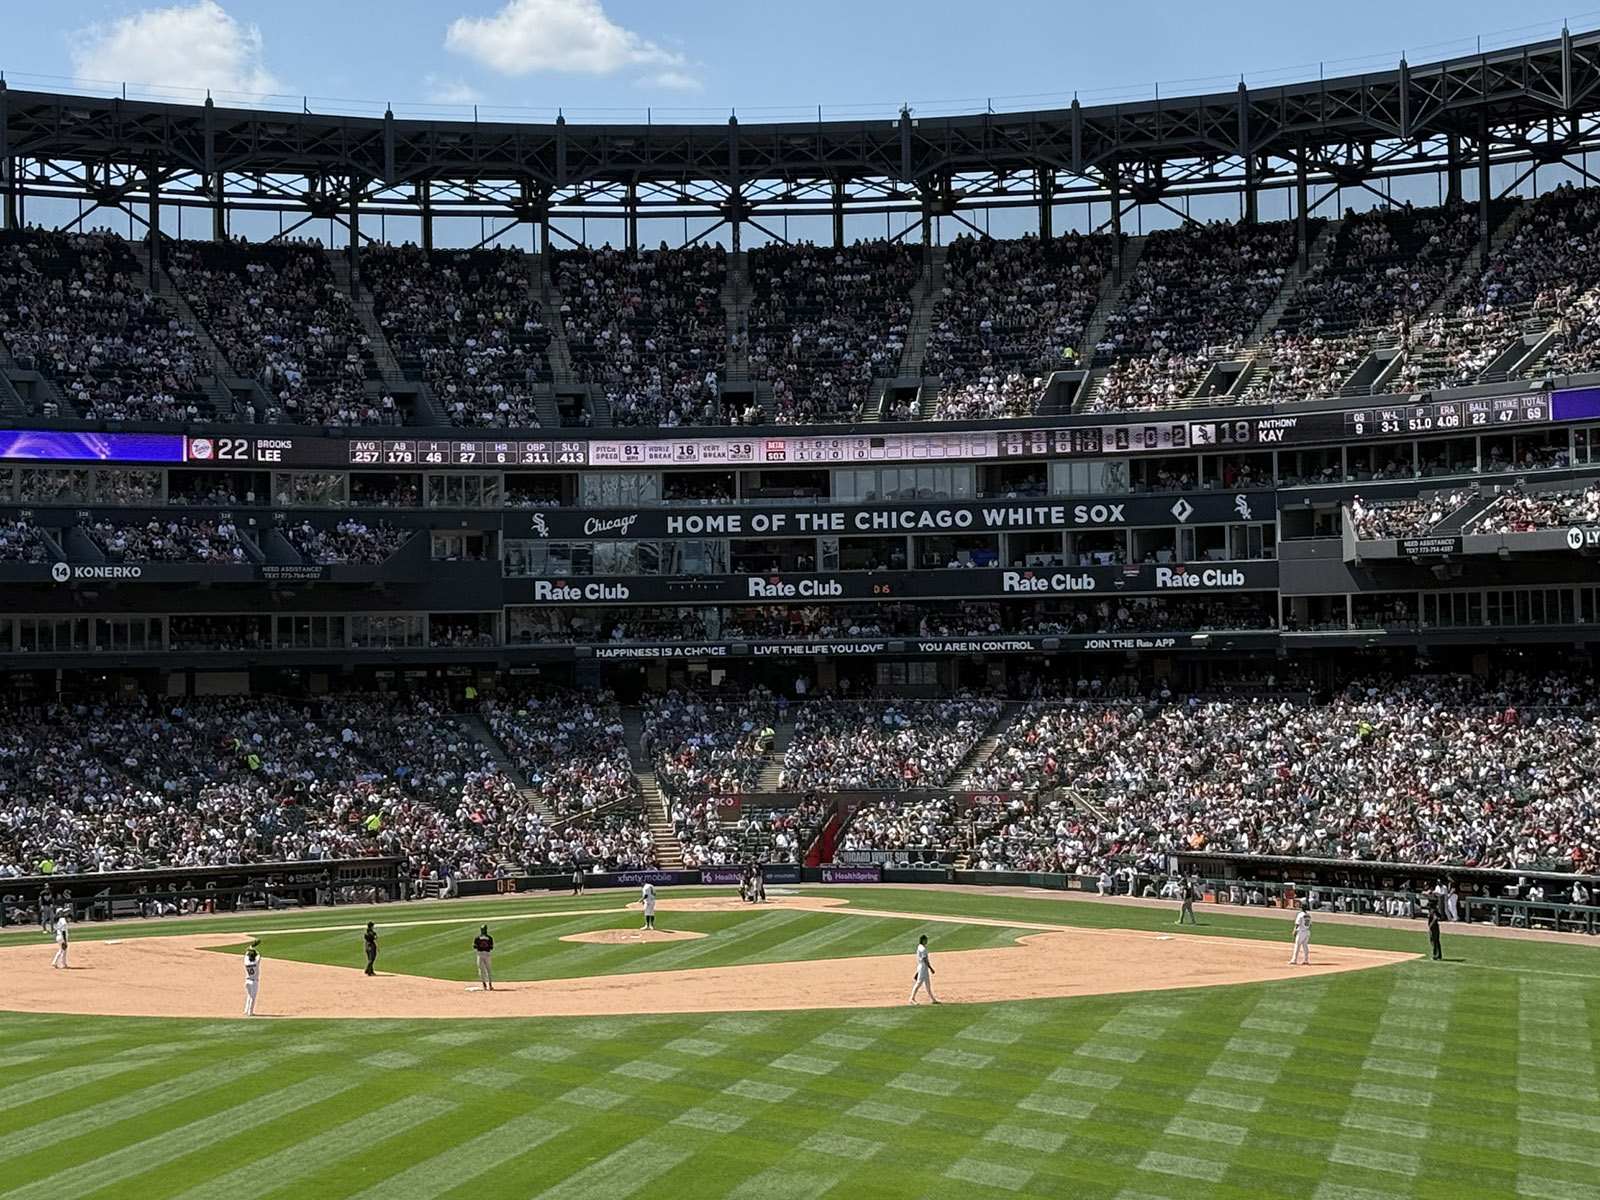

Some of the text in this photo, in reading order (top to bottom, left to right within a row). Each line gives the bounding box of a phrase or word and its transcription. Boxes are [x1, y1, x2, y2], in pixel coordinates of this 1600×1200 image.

[1469, 396, 1545, 411] BALL STRIKE TOTAL
[1353, 413, 1365, 422] GS
[1416, 408, 1424, 417] IP
[1472, 407, 1541, 424] 22 47 69
[1258, 418, 1297, 429] ANTHONY
[1355, 423, 1364, 434] 9
[1381, 420, 1400, 432] 3-1
[1408, 418, 1431, 430] 51.0
[1220, 421, 1249, 443] 18
[1258, 429, 1284, 442] KAY
[218, 438, 249, 459] 22
[257, 439, 292, 449] BROOKS
[356, 442, 376, 450] AVG
[393, 442, 406, 450] AB
[460, 443, 475, 451] RBI
[495, 443, 508, 451] HR
[526, 443, 545, 451] OBP
[562, 443, 579, 451] SLG
[624, 445, 640, 455] 81
[679, 445, 694, 455] 16
[257, 450, 281, 461] LEE
[352, 451, 584, 463] .257 179 46 27 6 .311 .413
[767, 452, 785, 460] SOX
[667, 503, 1126, 534] HOME OF THE CHICAGO WHITE SOX
[583, 514, 639, 536] Chicago
[1570, 533, 1581, 544] 16
[54, 567, 68, 577] 14
[74, 566, 142, 578] KONERKO
[1155, 567, 1245, 588] Rate Club
[747, 577, 843, 598] Rate Club
[1002, 571, 1096, 592] Rate Club
[534, 580, 630, 601] Rate Club
[753, 643, 884, 655] LIVE THE LIFE YOU LOVE
[918, 641, 1035, 651] YOU ARE IN CONTROL
[1084, 639, 1111, 649] JOIN
[1111, 639, 1134, 649] THE
[1154, 638, 1176, 648] APP
[596, 646, 726, 658] HAPPINESS IS A CHOICE
[871, 851, 894, 862] WHITE
[894, 851, 909, 862] SOX
[618, 872, 672, 883] xfinity mobile
[834, 872, 878, 881] HealthSpring
